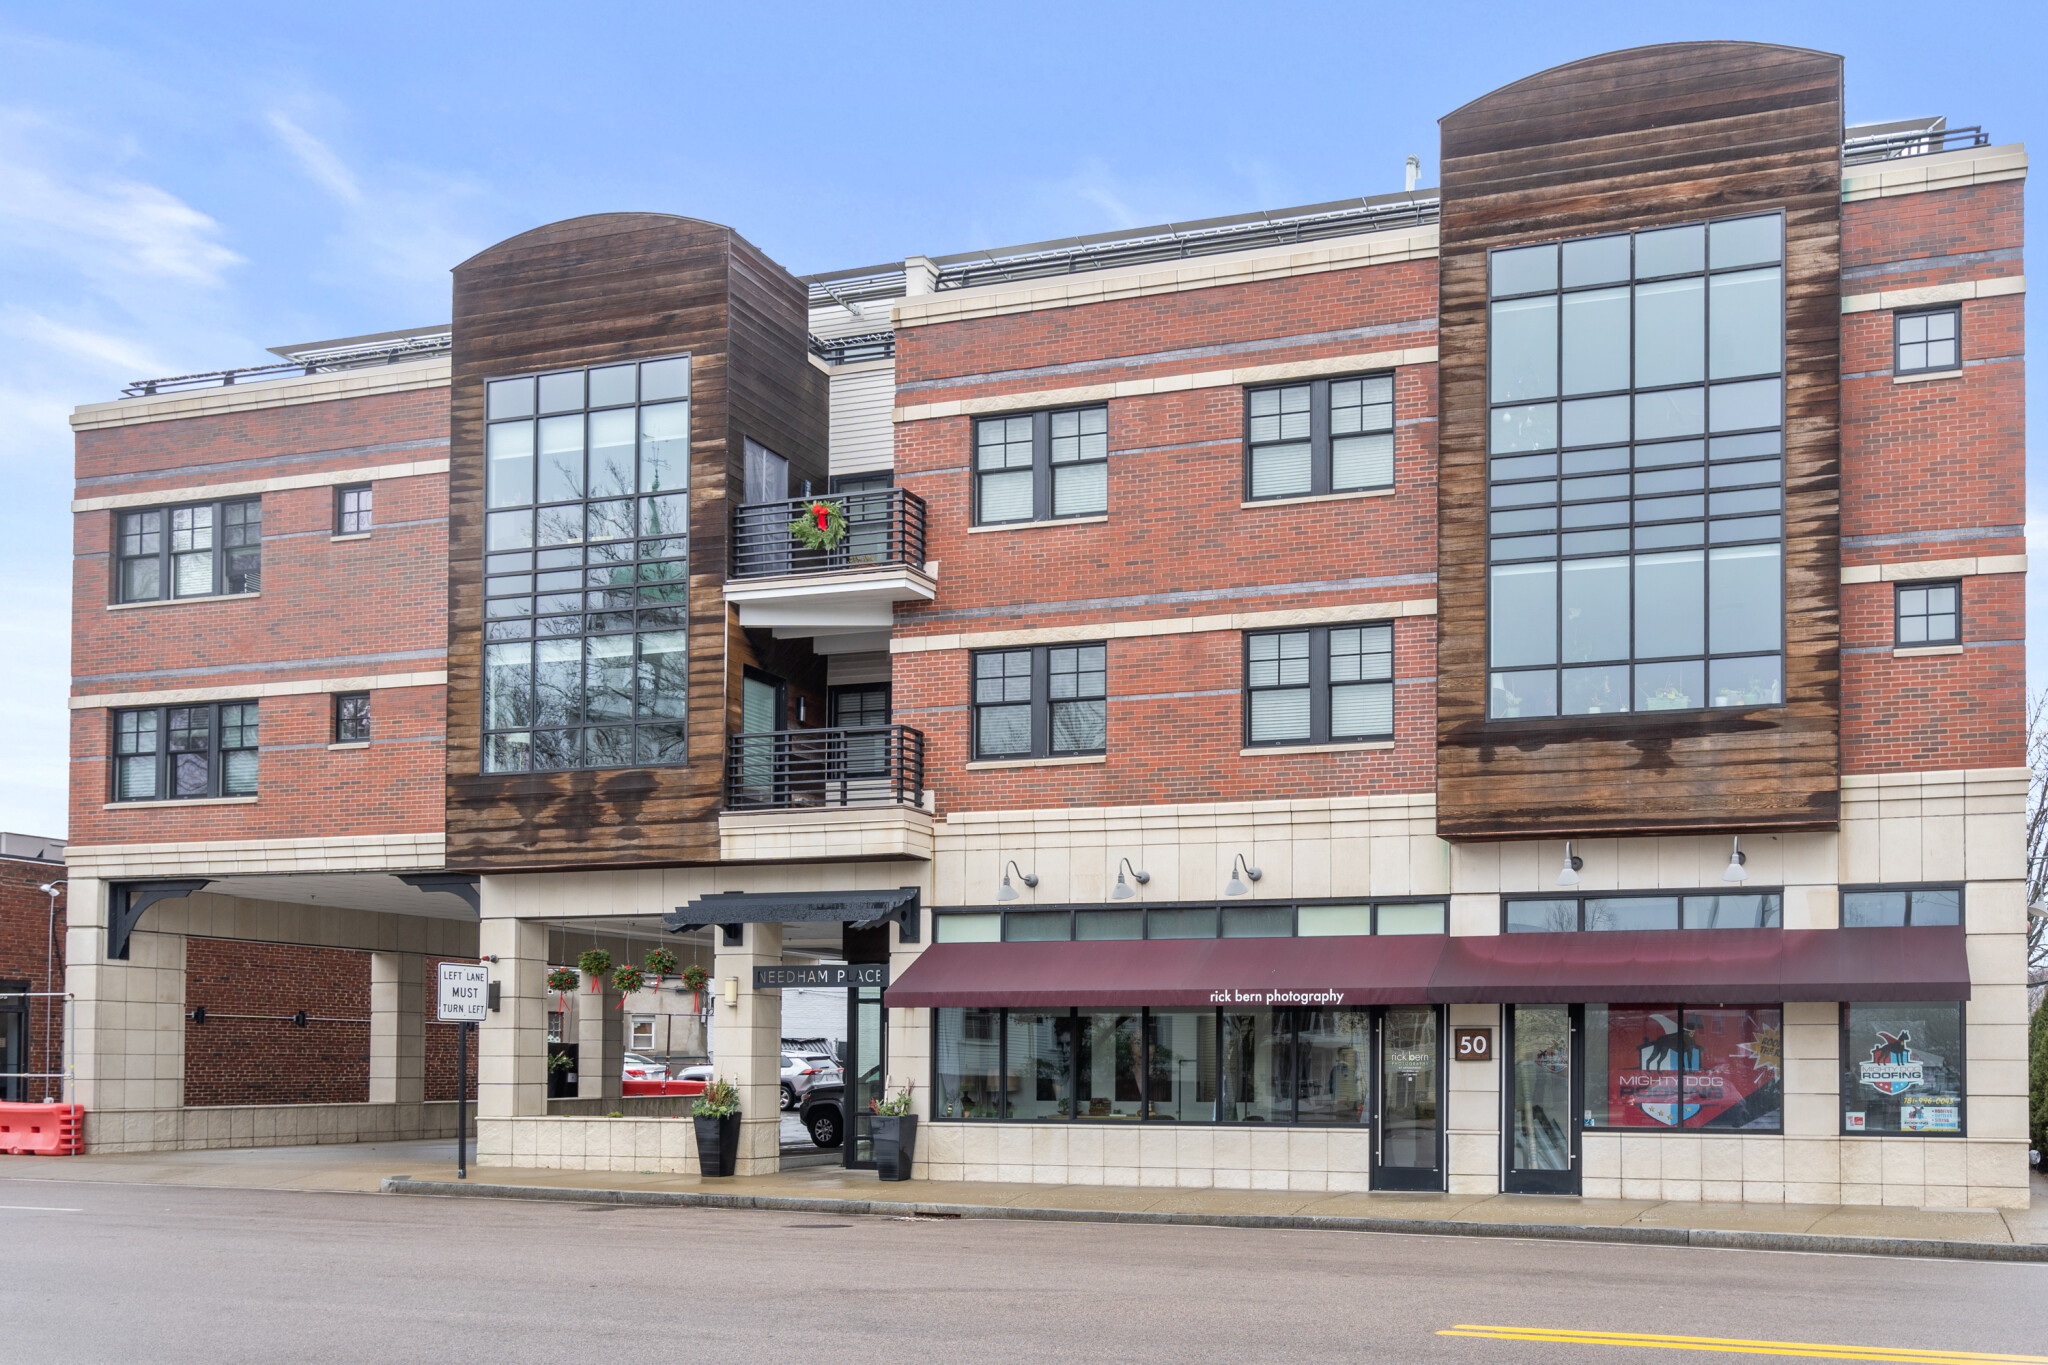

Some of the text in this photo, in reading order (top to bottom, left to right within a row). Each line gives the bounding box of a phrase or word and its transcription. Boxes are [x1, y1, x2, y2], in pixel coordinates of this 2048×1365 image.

[444, 971, 484, 981] LEFT LANE
[758, 969, 883, 983] NEEDHAM PLACE
[452, 987, 478, 998] MUST
[1210, 988, 1344, 1005] rick bern photography
[443, 1004, 484, 1014] TURN LEFT
[1460, 1035, 1487, 1054] 50
[1391, 1050, 1429, 1061] rick bern
[1619, 1075, 1724, 1087] MIGHTY DOG
